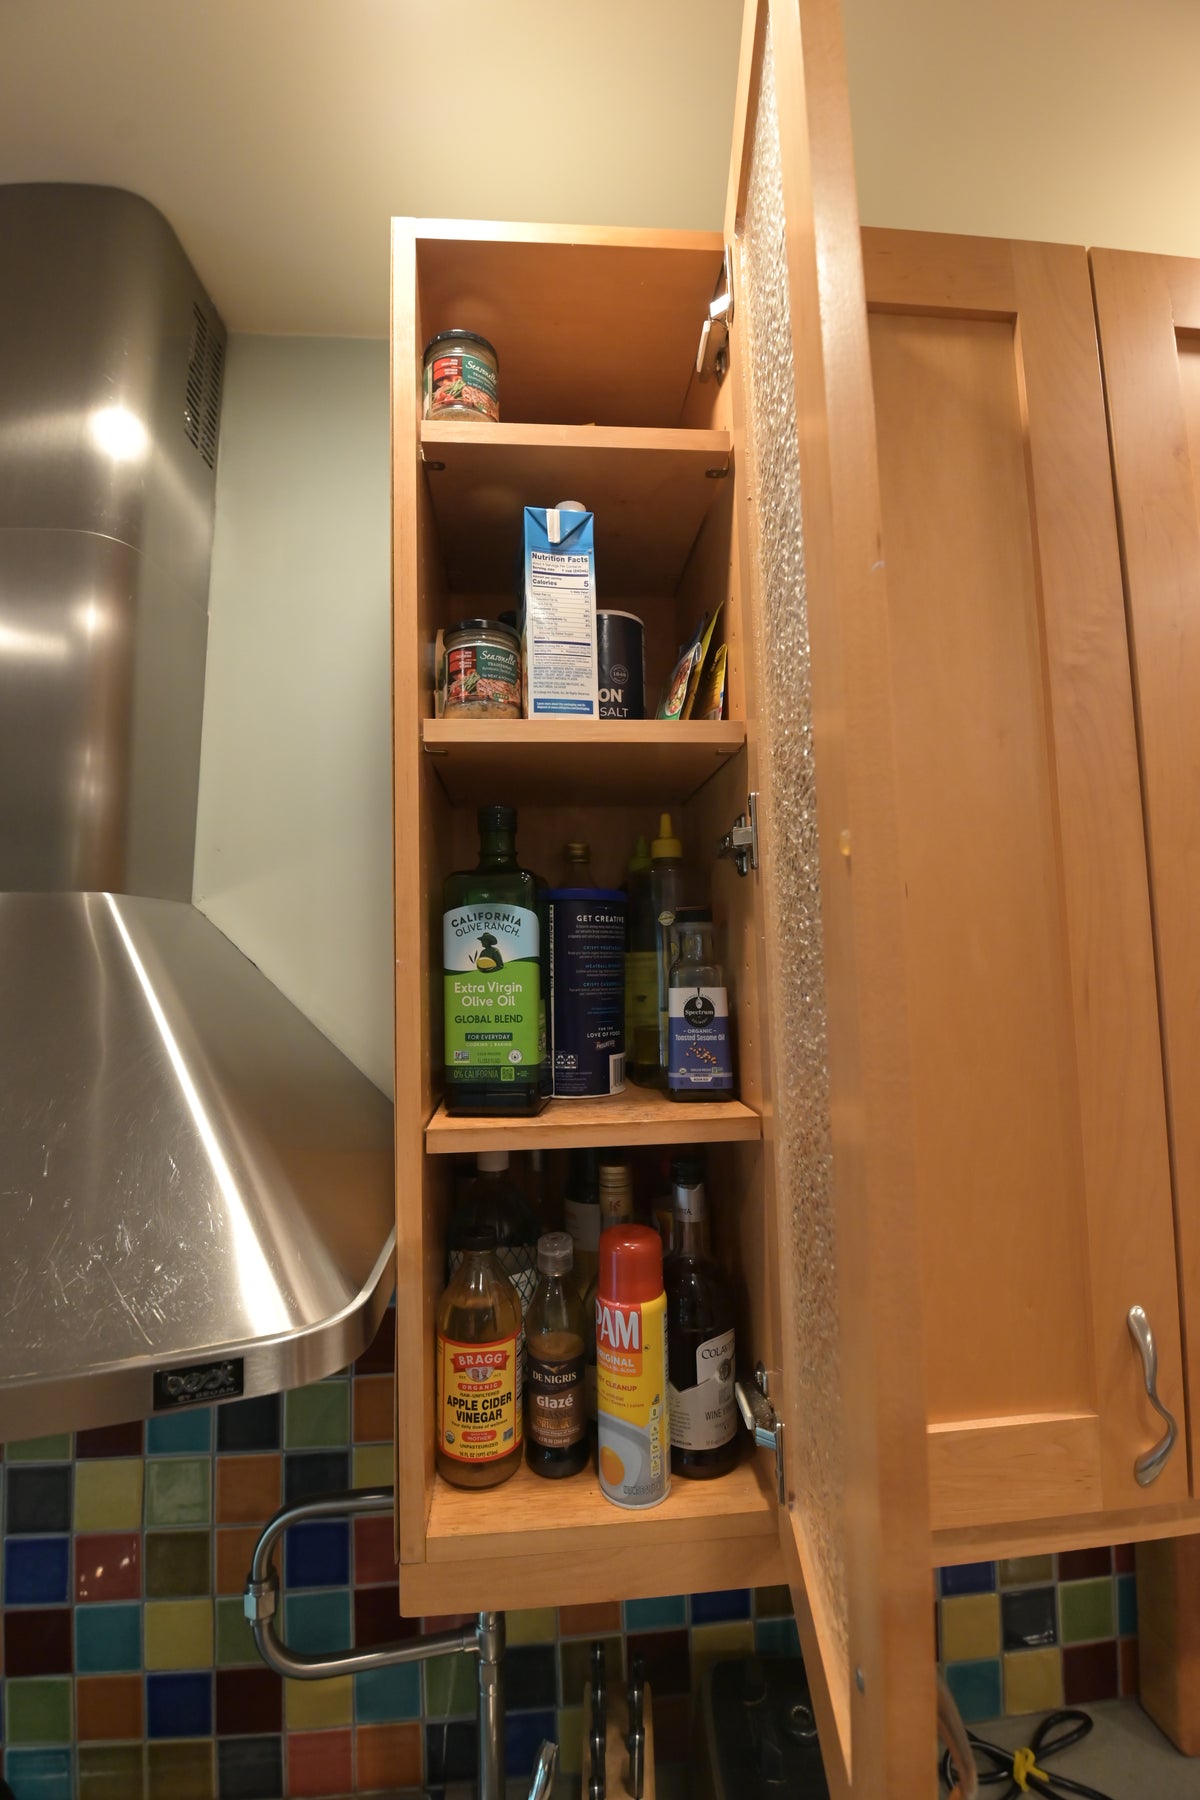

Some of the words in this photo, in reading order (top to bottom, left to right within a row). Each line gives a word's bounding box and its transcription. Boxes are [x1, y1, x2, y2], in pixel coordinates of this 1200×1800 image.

[532, 553, 565, 562] Nutrition
[600, 707, 628, 717] SALT
[451, 912, 521, 927] CALIFORNIA
[594, 915, 624, 923] CREATIVE
[456, 922, 482, 937] OLIVE
[454, 982, 485, 993] Extra
[487, 981, 522, 994] Virgin
[461, 995, 493, 1006] Olive
[497, 995, 515, 1006] Oil
[454, 1015, 491, 1023] GLOBAL
[494, 1015, 523, 1023] BLEND
[458, 1354, 502, 1365] BRAGG
[533, 1370, 543, 1382] DE
[544, 1372, 577, 1384] NIGRIS
[462, 1382, 498, 1390] ORGANIC
[605, 1380, 637, 1392] CLEANUP
[447, 1395, 478, 1411] APPLE
[481, 1392, 512, 1411] CIDER
[537, 1394, 574, 1409] Glazé
[456, 1408, 502, 1423] VINEGAR
[705, 1408, 722, 1421] WINE
